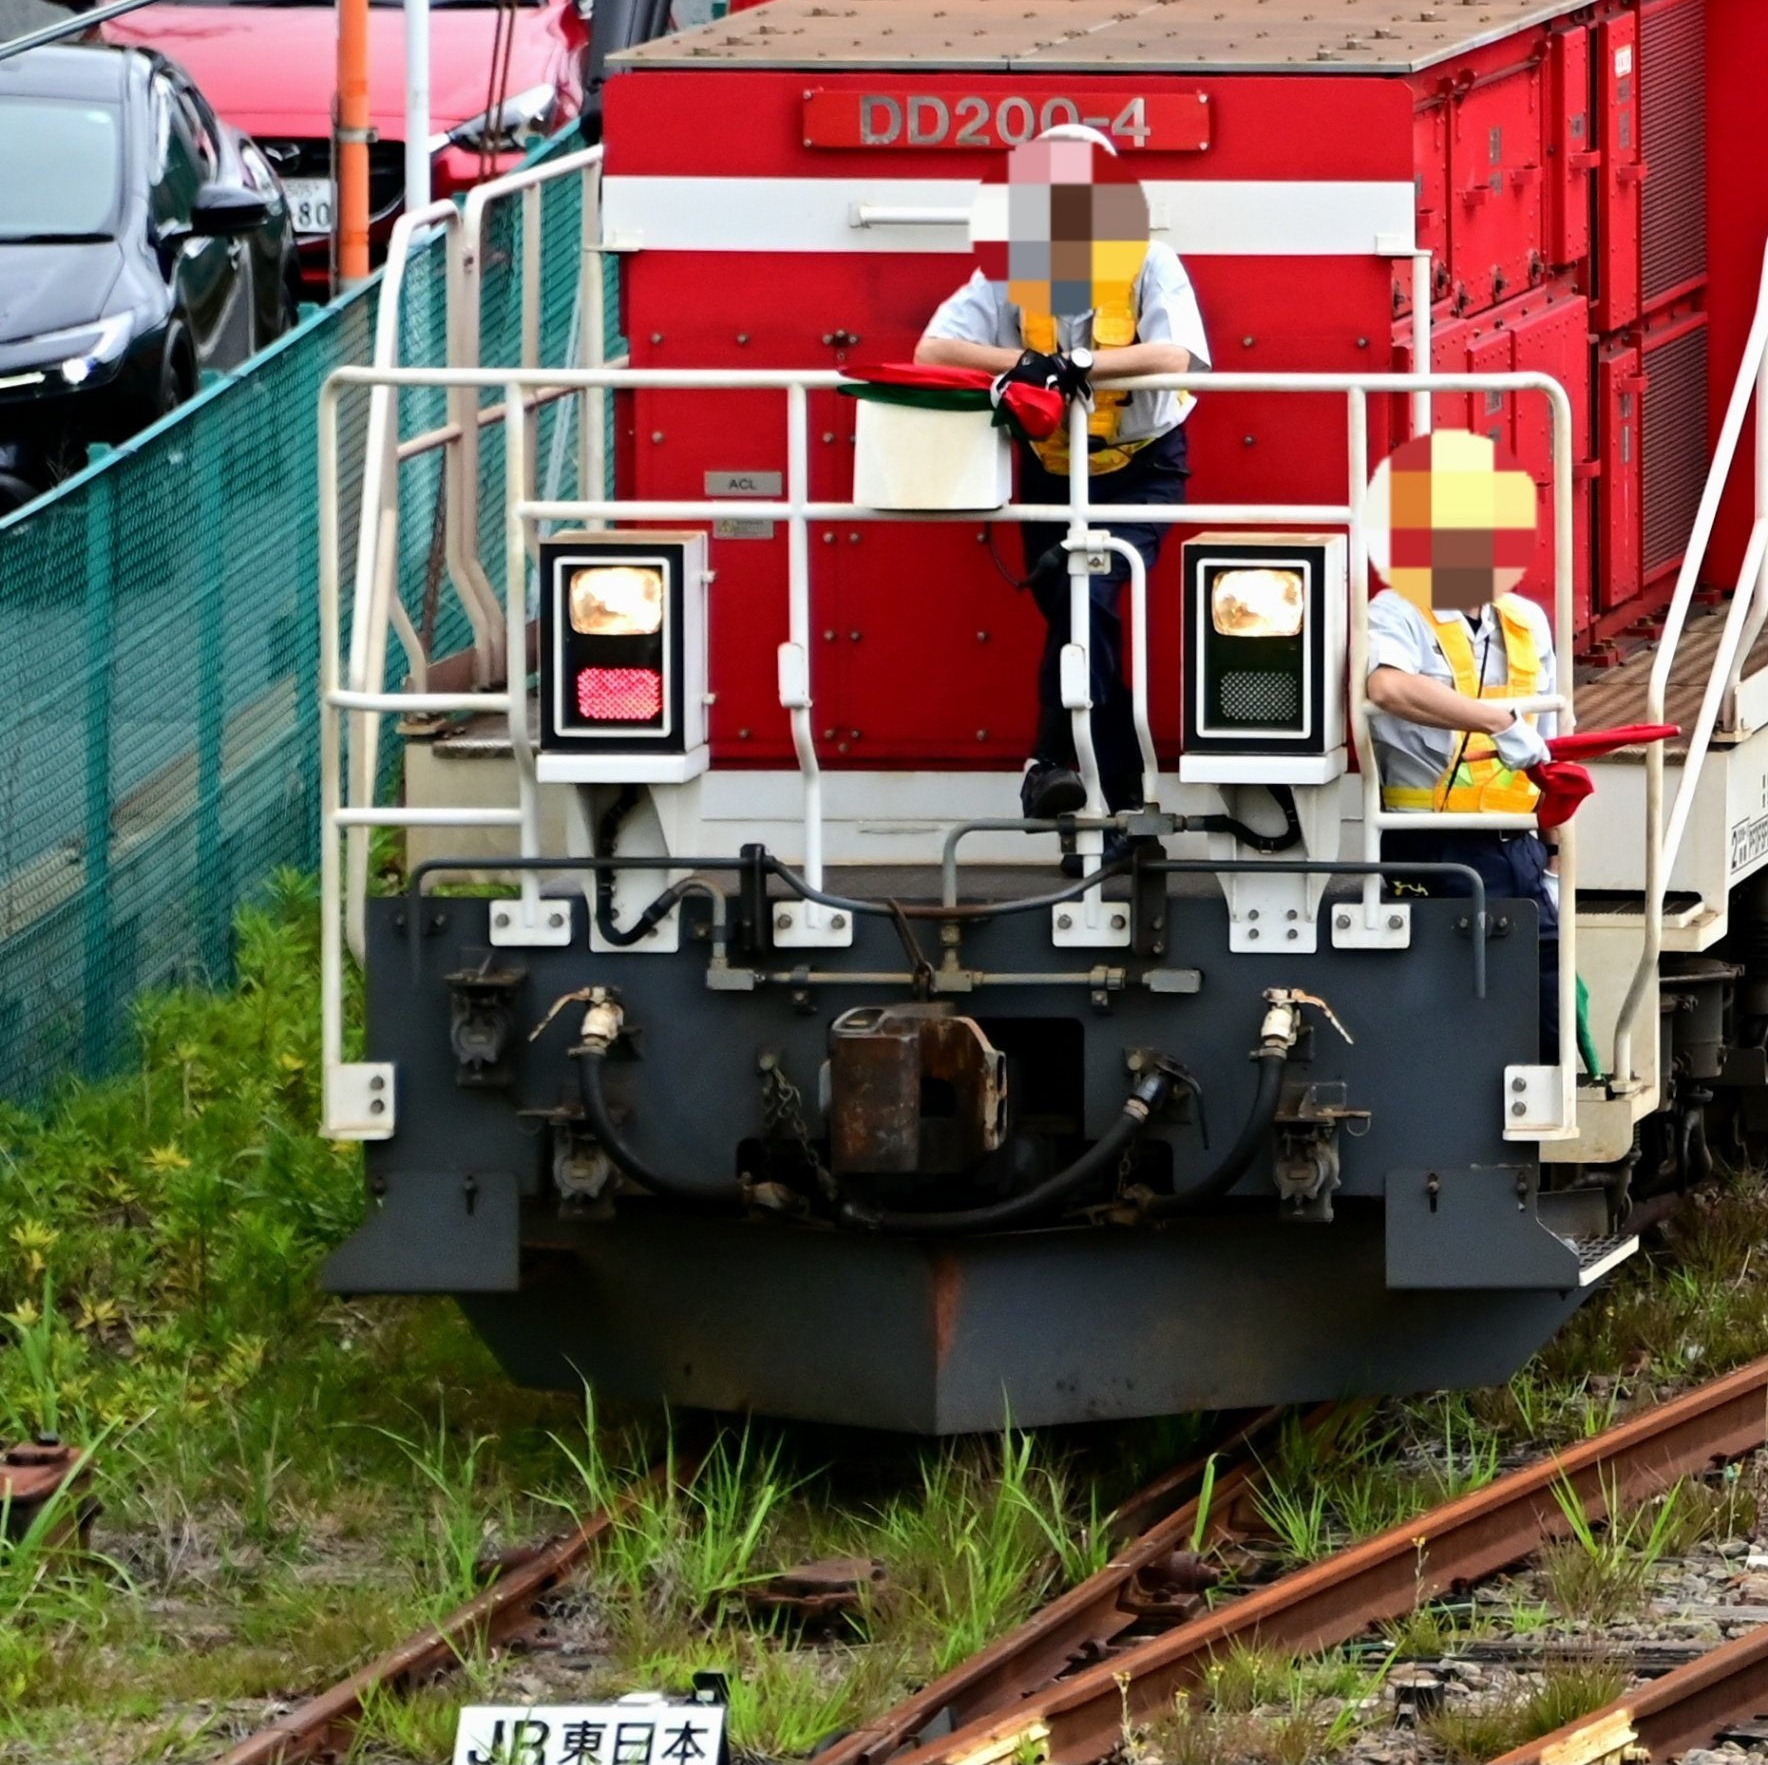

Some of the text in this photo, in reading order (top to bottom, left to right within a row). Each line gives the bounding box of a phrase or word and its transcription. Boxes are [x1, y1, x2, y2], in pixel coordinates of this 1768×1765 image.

[859, 95, 1151, 148] DD200-4
[728, 478, 757, 491] ACL
[466, 1719, 709, 1765] JR東日本
